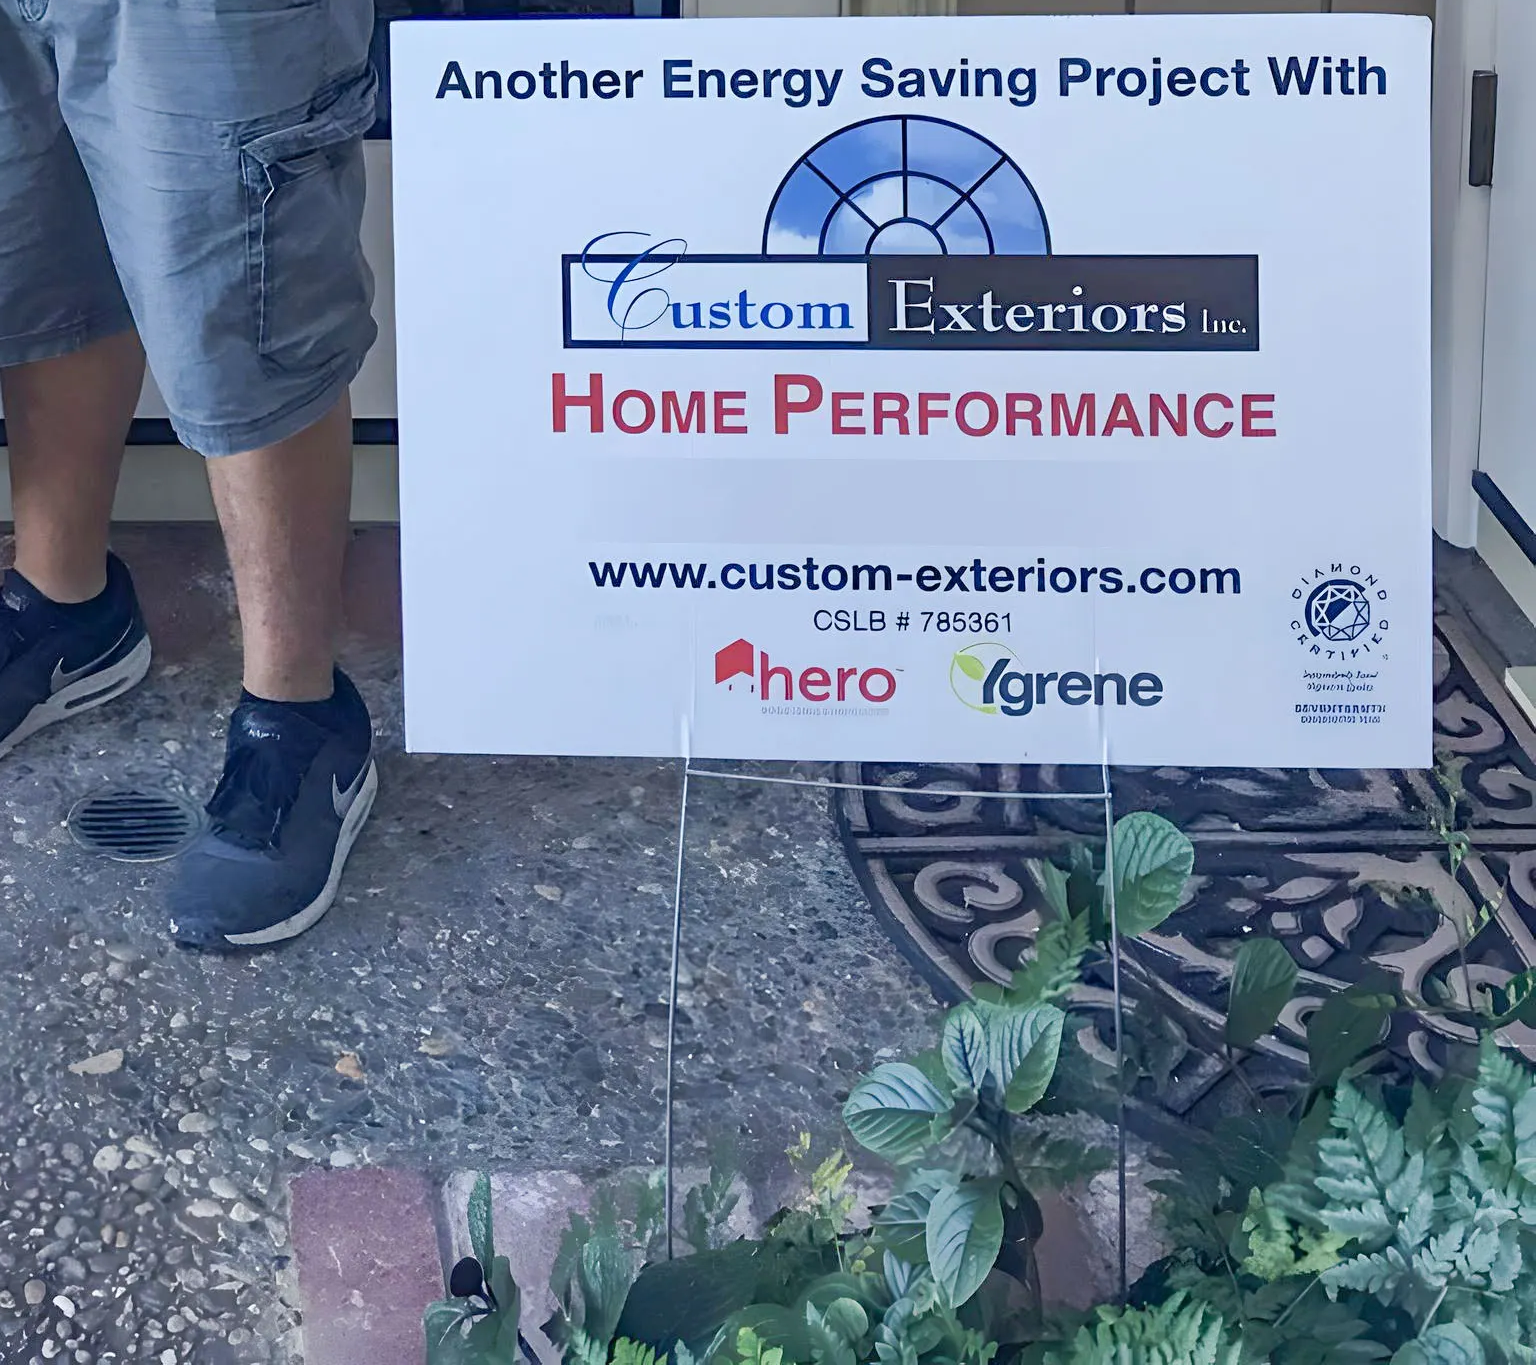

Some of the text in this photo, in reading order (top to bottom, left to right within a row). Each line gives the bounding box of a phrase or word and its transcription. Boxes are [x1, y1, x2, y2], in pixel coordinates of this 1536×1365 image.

[435, 56, 1386, 108] Another Energy Saving Project With
[581, 231, 1248, 343] Custom Exteriors Inc.
[552, 373, 1277, 438] HOME PERFORMANCE
[589, 556, 1241, 595] www.custom-exteriors.com
[1291, 563, 1388, 601] DIAMOND
[813, 610, 1011, 633] CSLB # 785361
[760, 650, 897, 703] hero
[954, 652, 1164, 717] Ygrene
